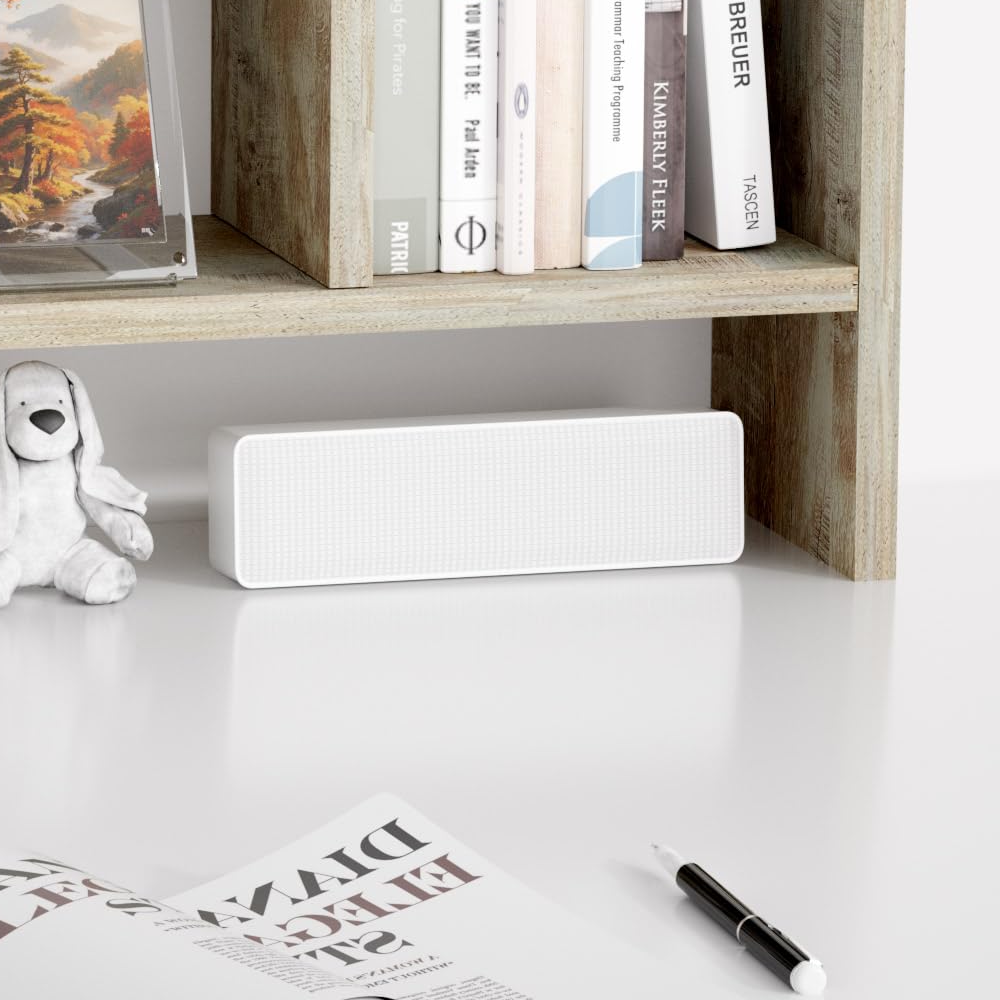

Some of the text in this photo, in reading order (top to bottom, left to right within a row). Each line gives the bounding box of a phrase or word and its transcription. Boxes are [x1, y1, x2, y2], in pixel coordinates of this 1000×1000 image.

[391, 17, 407, 38] for
[464, 3, 482, 24] YOU
[391, 44, 407, 96] Pirates
[464, 29, 481, 59] WANT
[610, 39, 626, 82] Teaching
[727, 2, 751, 89] BREUER
[464, 64, 481, 77] TO
[610, 84, 625, 142] Programme
[463, 119, 481, 179] Paul Arden
[652, 81, 670, 232] KIMBERLY FLEEK
[742, 174, 760, 231] TASCEN
